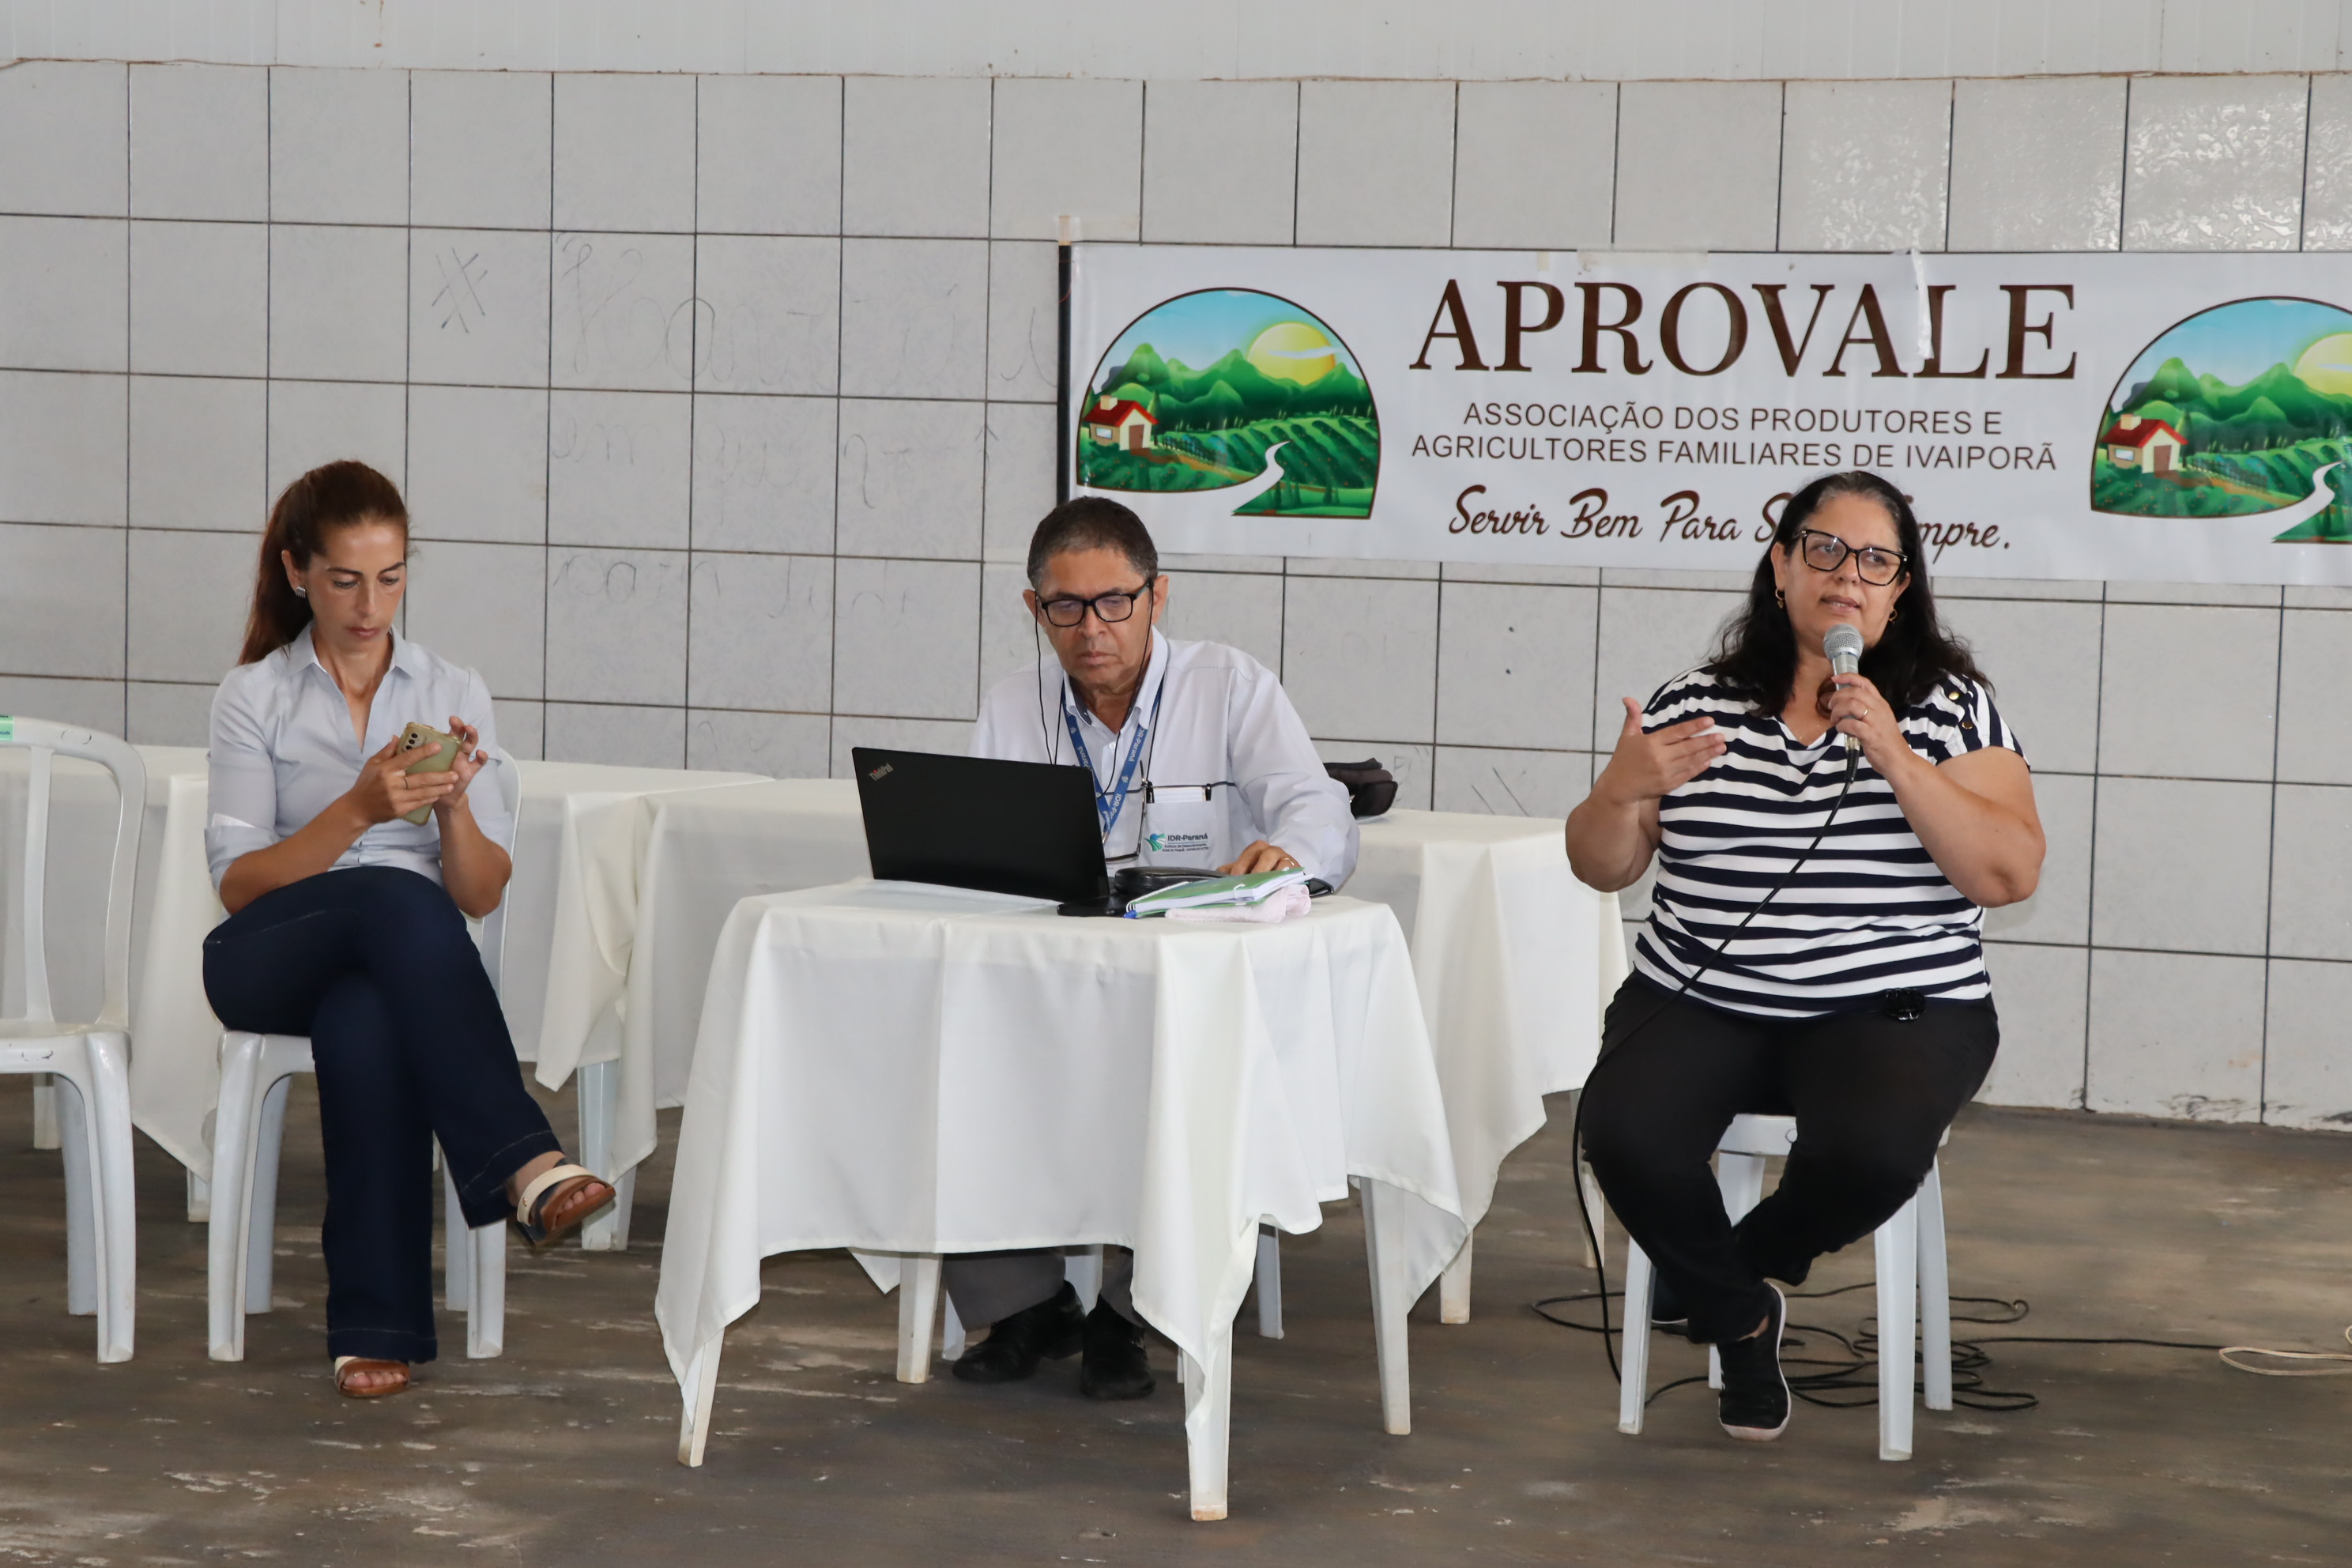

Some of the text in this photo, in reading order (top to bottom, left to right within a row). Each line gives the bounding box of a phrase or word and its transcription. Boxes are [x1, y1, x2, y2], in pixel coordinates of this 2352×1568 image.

[1408, 278, 2078, 379] APROVALE
[1464, 401, 2002, 435] ASSOCIAÇÃO DOS PRODUTORES E
[1412, 435, 2056, 470] AGRICULTORES FAMILIARES DE IVAIPORÃ
[1448, 484, 1551, 536] Servir
[1560, 487, 1644, 539] Bem
[1660, 489, 1743, 543] Para
[1906, 495, 2011, 564] mpre.
[1167, 832, 1208, 842] IDR-Paraná
